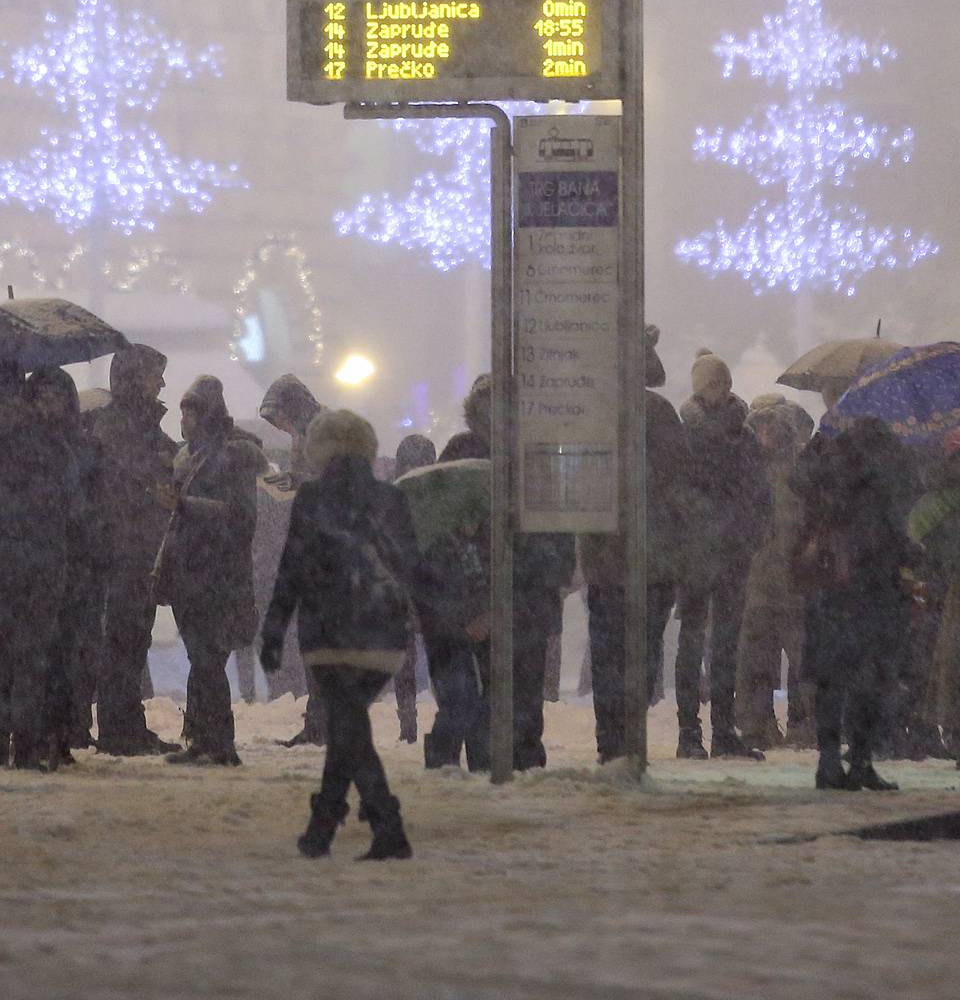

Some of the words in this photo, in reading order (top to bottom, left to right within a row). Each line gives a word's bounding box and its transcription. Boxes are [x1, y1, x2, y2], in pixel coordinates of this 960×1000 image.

[324, 2, 346, 20] 12
[365, 1, 480, 20] Ljubljanica
[542, 0, 587, 18] 0min
[324, 21, 346, 40] 14
[534, 19, 585, 37] 18:55
[324, 41, 346, 59] 14
[543, 38, 585, 57] 1min
[324, 61, 346, 80] 17
[365, 60, 436, 80] Prečko
[542, 58, 587, 77] 2min
[521, 345, 536, 363] 13
